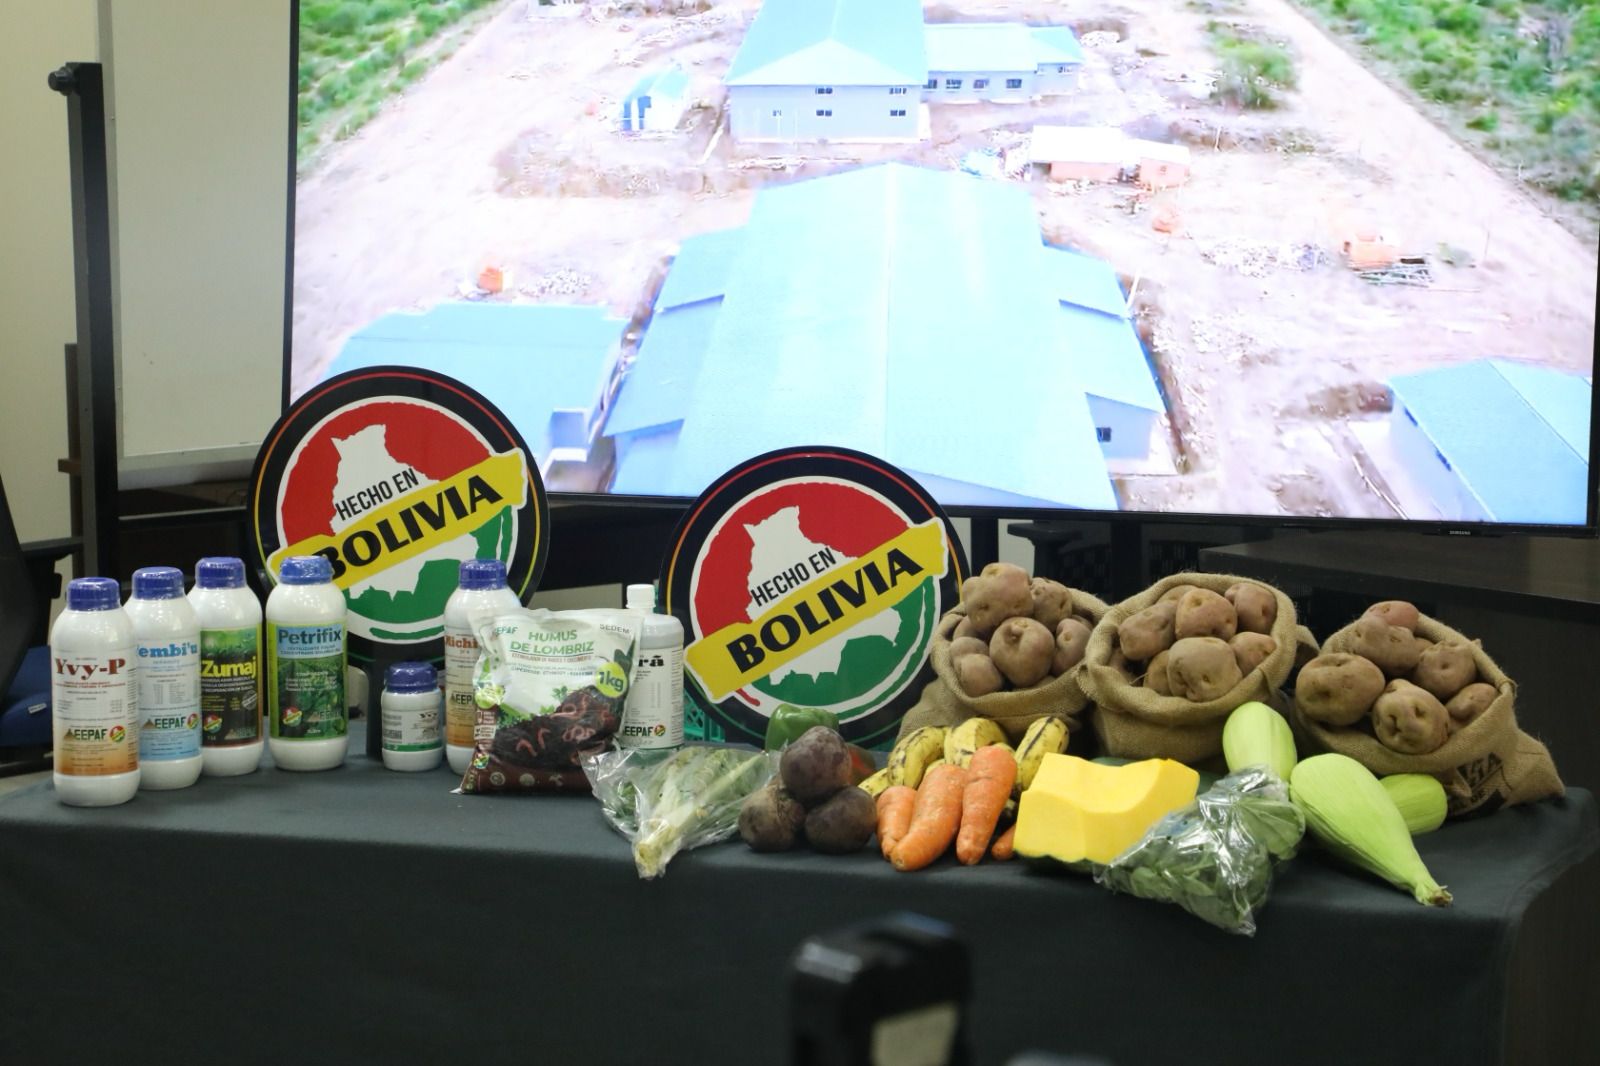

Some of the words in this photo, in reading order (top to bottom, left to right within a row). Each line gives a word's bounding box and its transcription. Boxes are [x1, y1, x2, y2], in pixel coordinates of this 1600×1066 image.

[335, 480, 393, 521] HECHO
[392, 467, 419, 494] EN
[311, 474, 503, 580] BOLIVIA
[750, 562, 811, 607] HECHO
[808, 547, 837, 574] EN
[726, 548, 924, 674] BOLIVIA
[278, 628, 342, 645] Petrifix
[528, 630, 578, 642] HUMUS
[137, 642, 198, 658] embi'u
[510, 641, 530, 651] DE
[533, 641, 594, 655] LOMBRIZ
[55, 657, 126, 680] Yvy-P
[201, 655, 257, 679] Zumaj
[599, 671, 624, 692] 1kg
[456, 694, 472, 705] EEP
[154, 716, 187, 729] EEPAF
[73, 728, 108, 741] EEPAF
